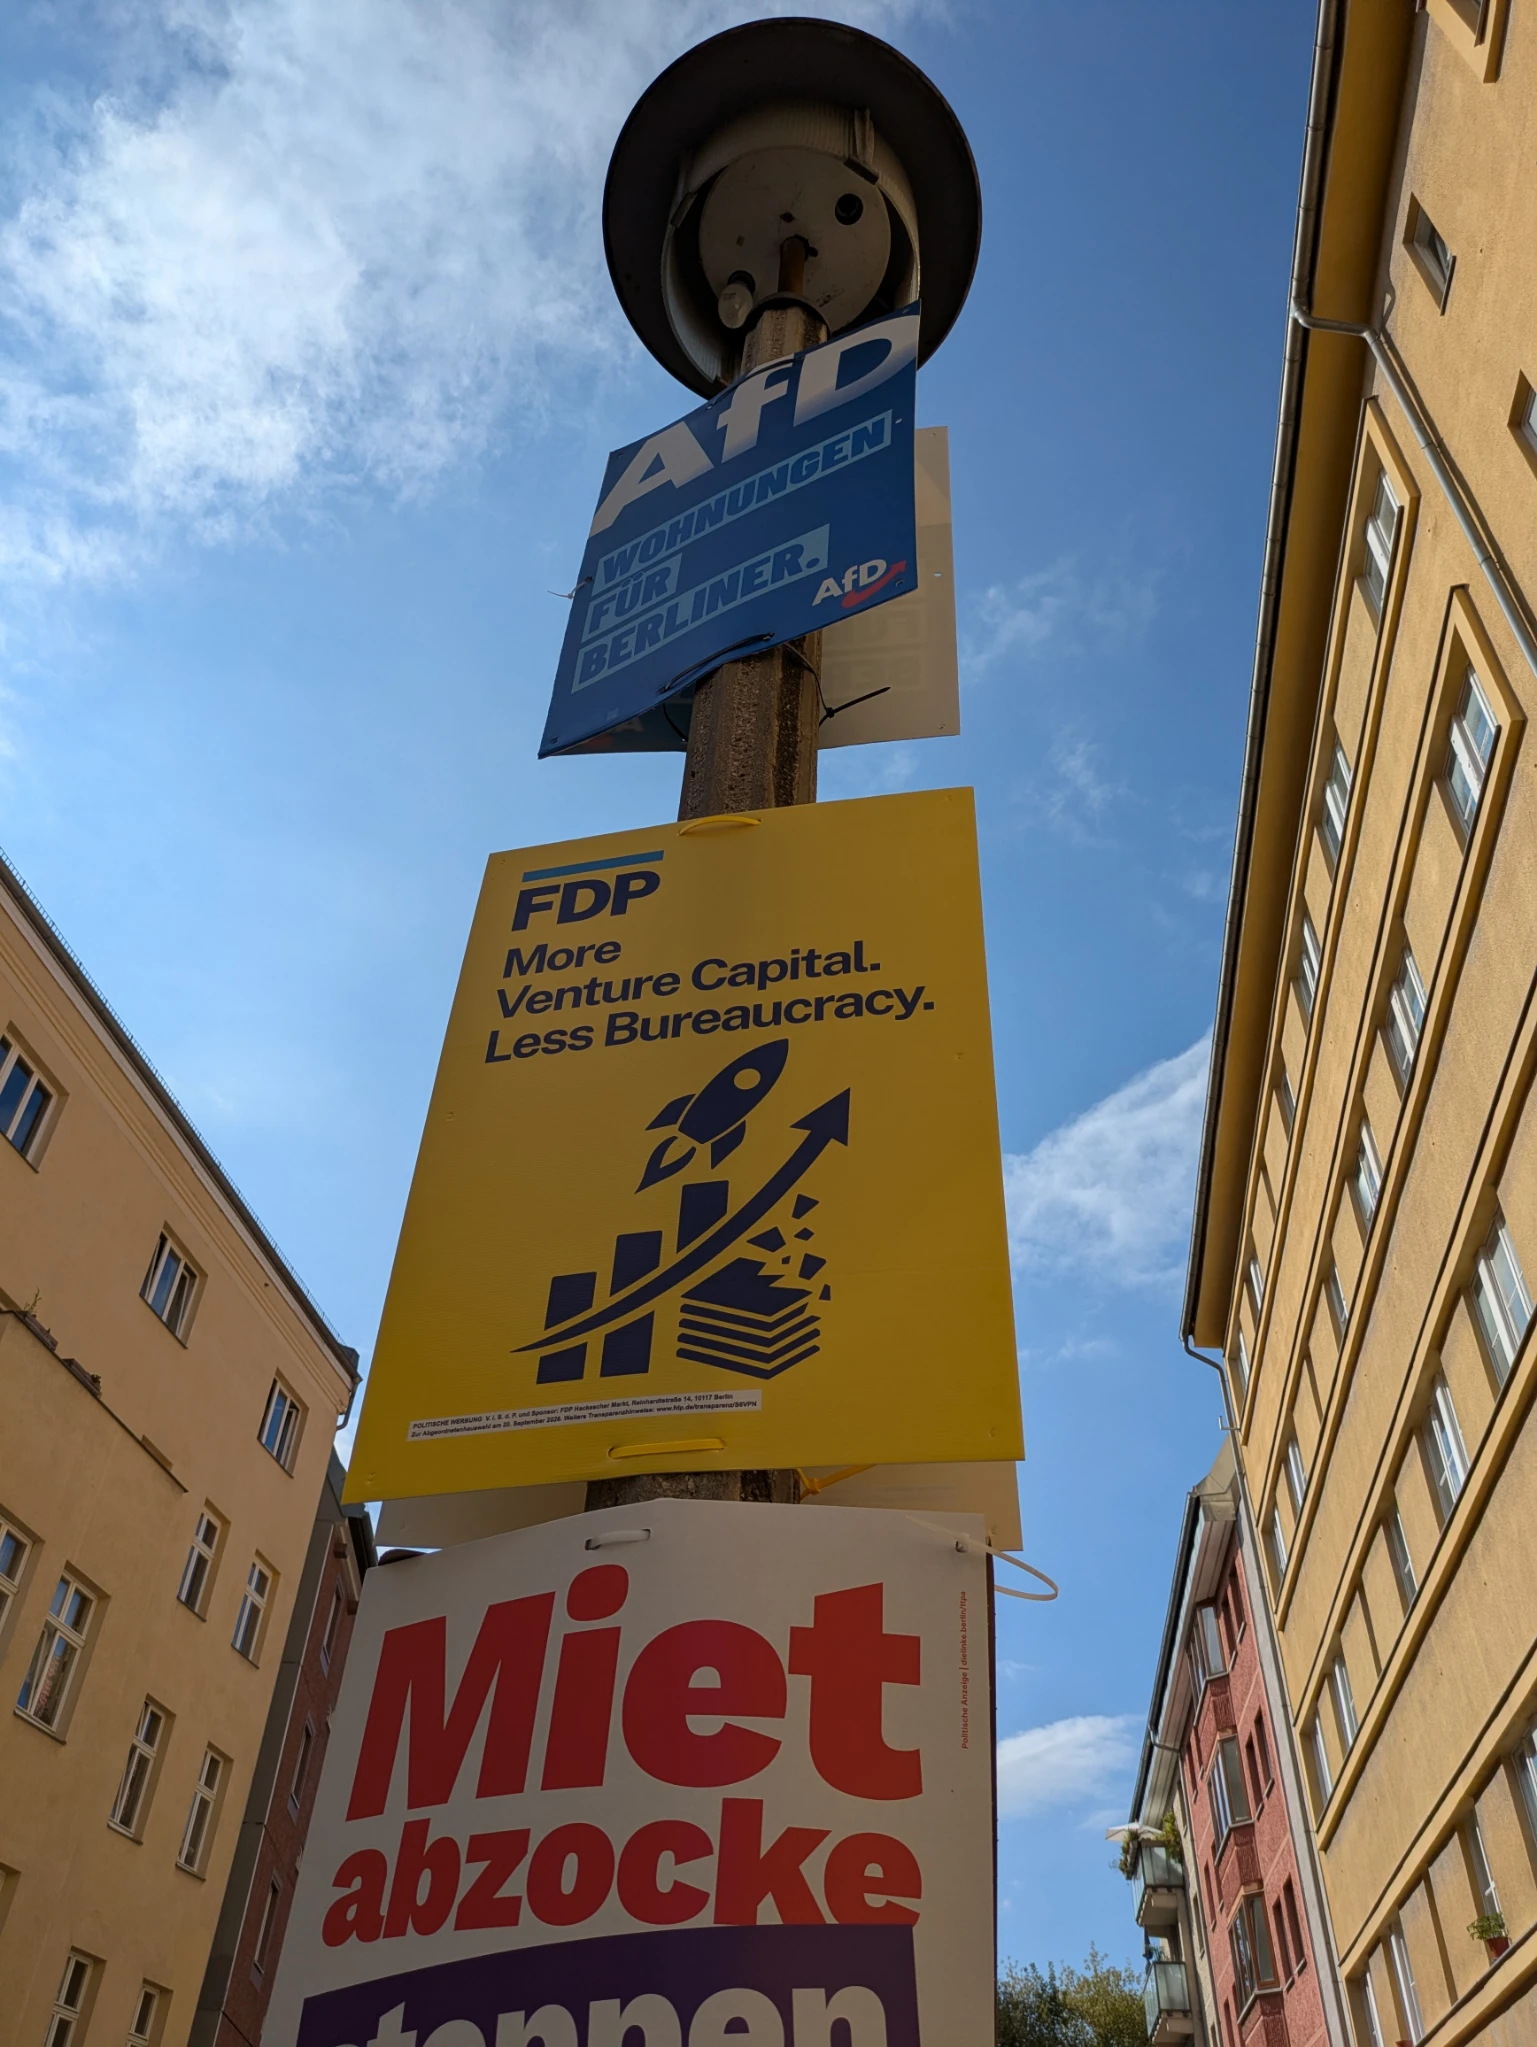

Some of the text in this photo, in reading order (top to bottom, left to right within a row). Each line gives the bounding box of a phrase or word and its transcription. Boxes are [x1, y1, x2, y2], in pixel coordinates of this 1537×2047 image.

[588, 314, 919, 540] AfD
[603, 418, 886, 587] WOHNUNGEN
[578, 542, 821, 686] BERLINER.
[587, 565, 673, 634] FÜR
[812, 558, 888, 606] AfD
[511, 870, 661, 932] FDP
[497, 940, 881, 1019] Venture Capital.
[502, 940, 622, 979] More
[484, 985, 935, 1064] Less Bureaucracy.
[411, 1430, 421, 1438] Zur
[513, 1417, 546, 1429] September
[563, 1413, 587, 1422] Weitere
[588, 1407, 655, 1420] Transparenzhinweise:
[412, 1419, 449, 1430] POLITISCHE
[451, 1416, 483, 1426] WERBUNG
[531, 1408, 558, 1418] Sponsor:
[574, 1402, 610, 1413] Hackescher
[611, 1400, 630, 1409] Markt,
[631, 1396, 682, 1407] Reinhardtstraße
[683, 1395, 693, 1403] 14,
[959, 1591, 969, 1666] dielinke.berlin/ttpa
[345, 1563, 923, 1823] Miet
[960, 1671, 970, 1706] Anzeige
[960, 1707, 969, 1749] Politische
[322, 1797, 922, 1947] abzocke
